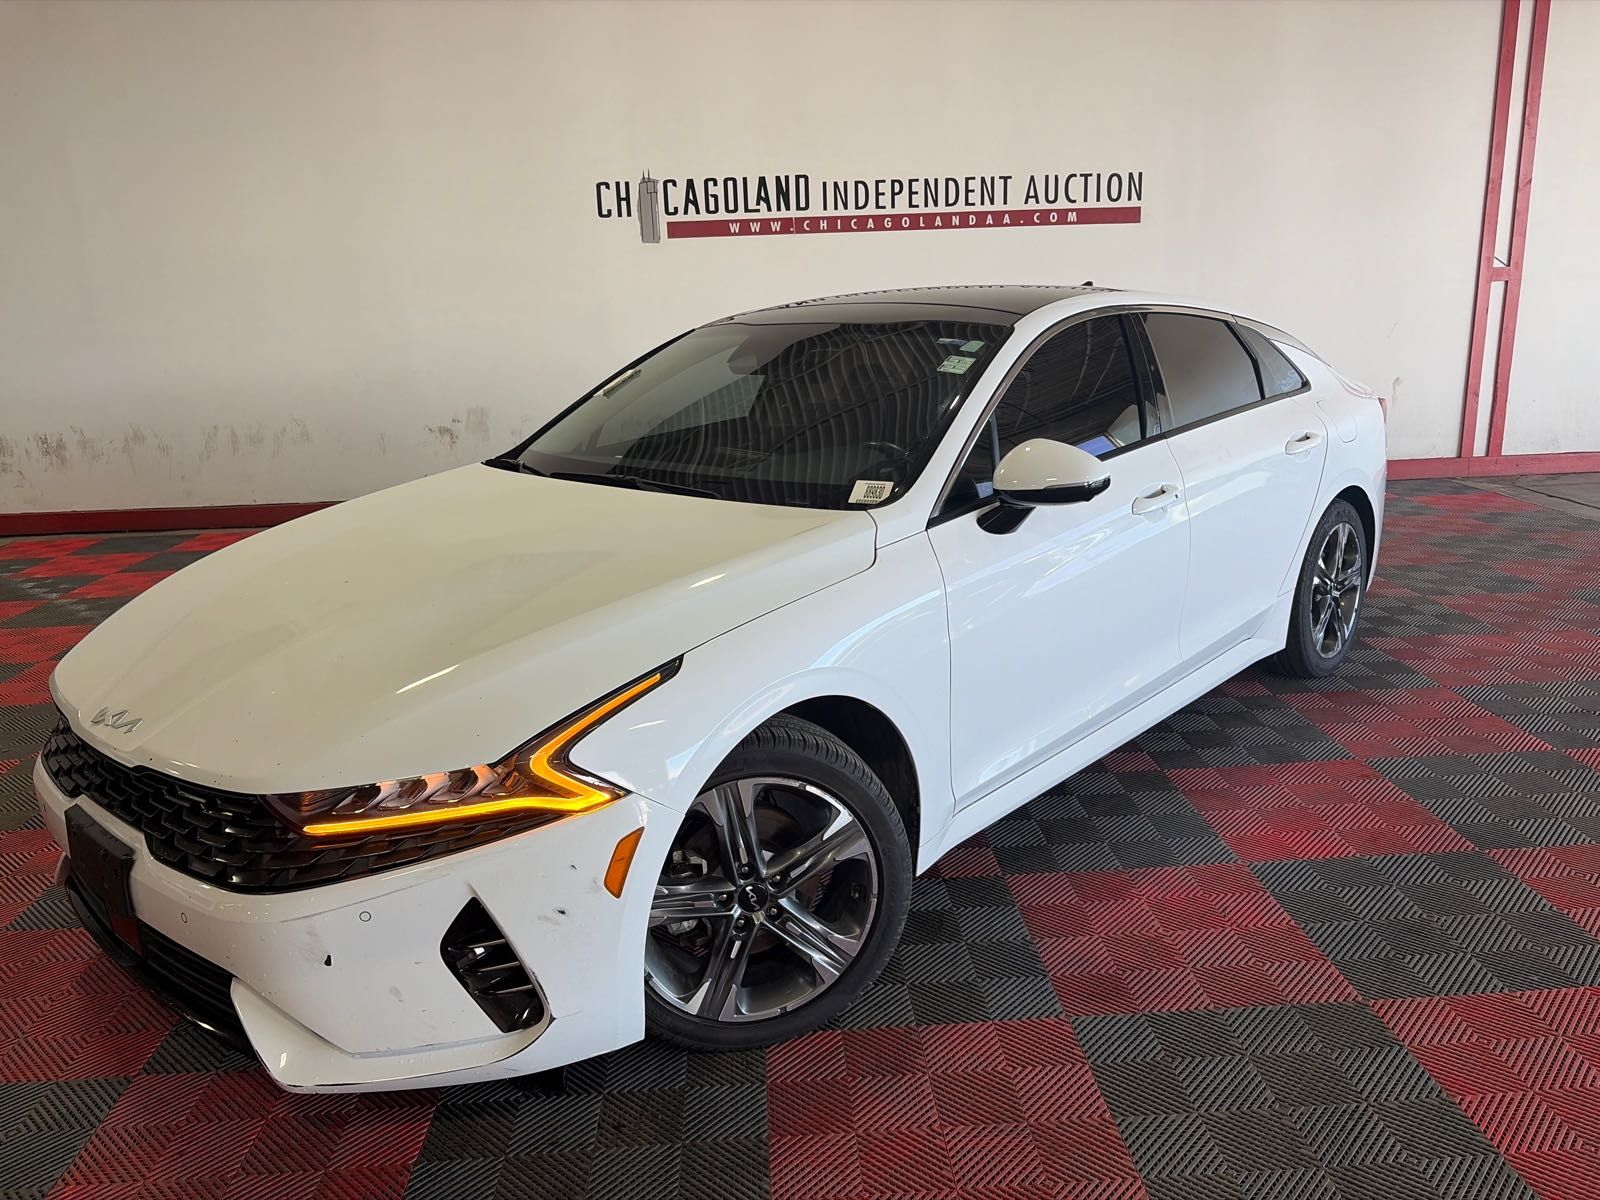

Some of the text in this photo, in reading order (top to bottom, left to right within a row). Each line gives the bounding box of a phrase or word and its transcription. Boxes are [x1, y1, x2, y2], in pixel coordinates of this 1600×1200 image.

[822, 175, 1013, 211] INDEPENDENT
[1023, 171, 1144, 205] AUCTION
[729, 211, 1078, 234] WWW.CHICAGOLANDAA.COM
